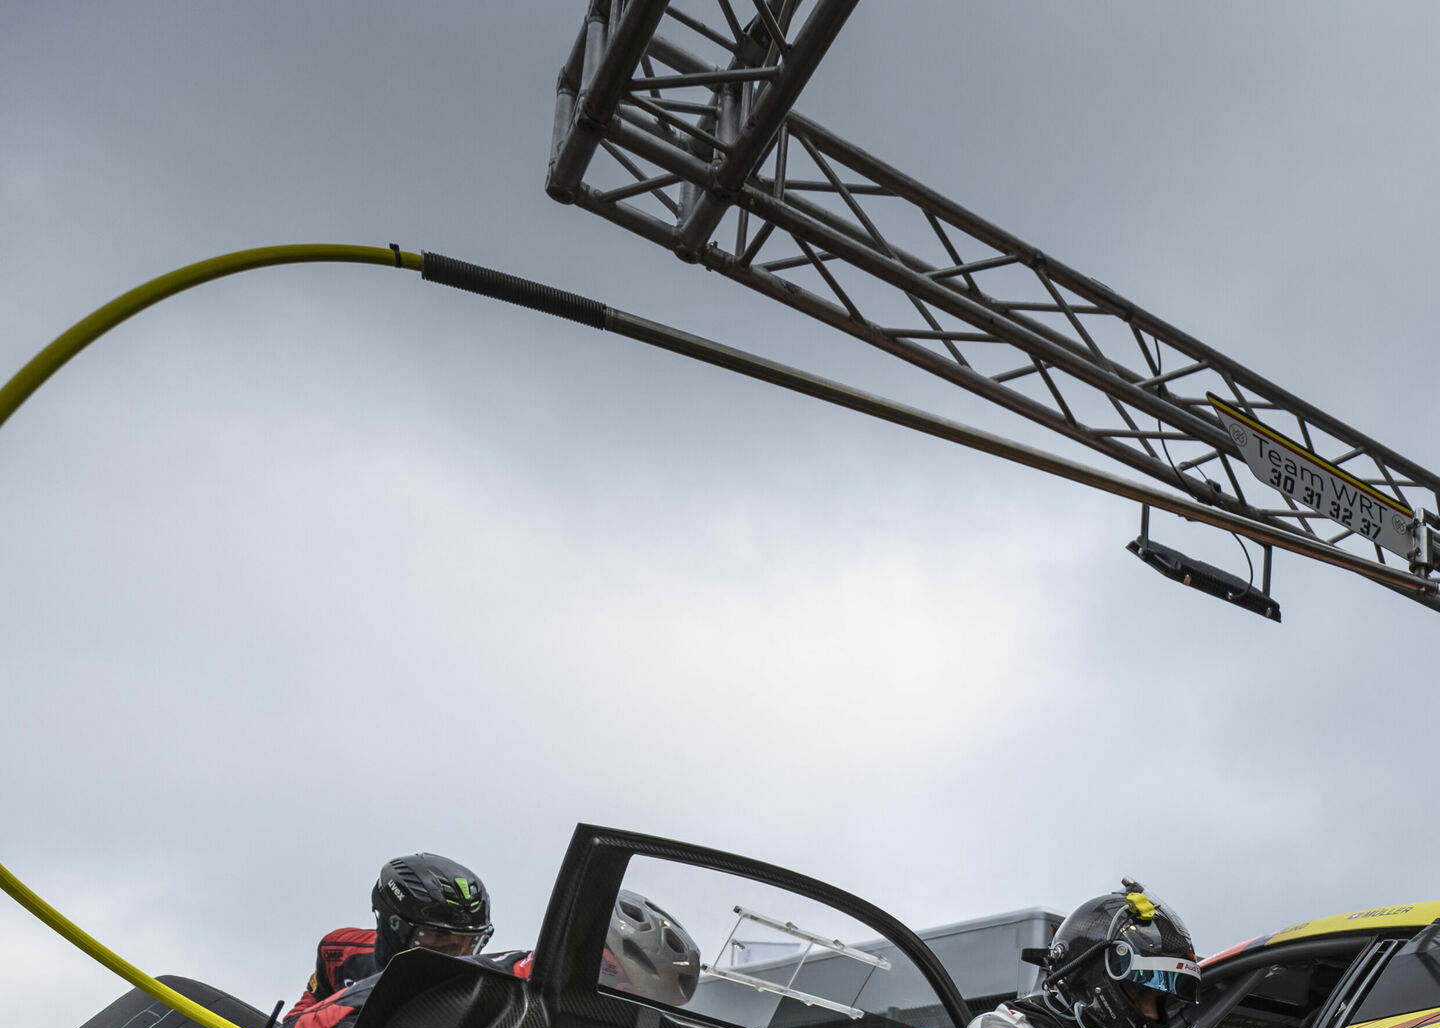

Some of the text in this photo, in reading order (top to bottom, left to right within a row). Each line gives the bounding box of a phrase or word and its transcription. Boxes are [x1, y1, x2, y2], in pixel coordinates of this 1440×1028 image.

[1252, 432, 1388, 524] Team WRT
[1269, 467, 1382, 540] 30 31 32 37
[387, 879, 405, 902] uvex
[324, 950, 343, 962] OMP
